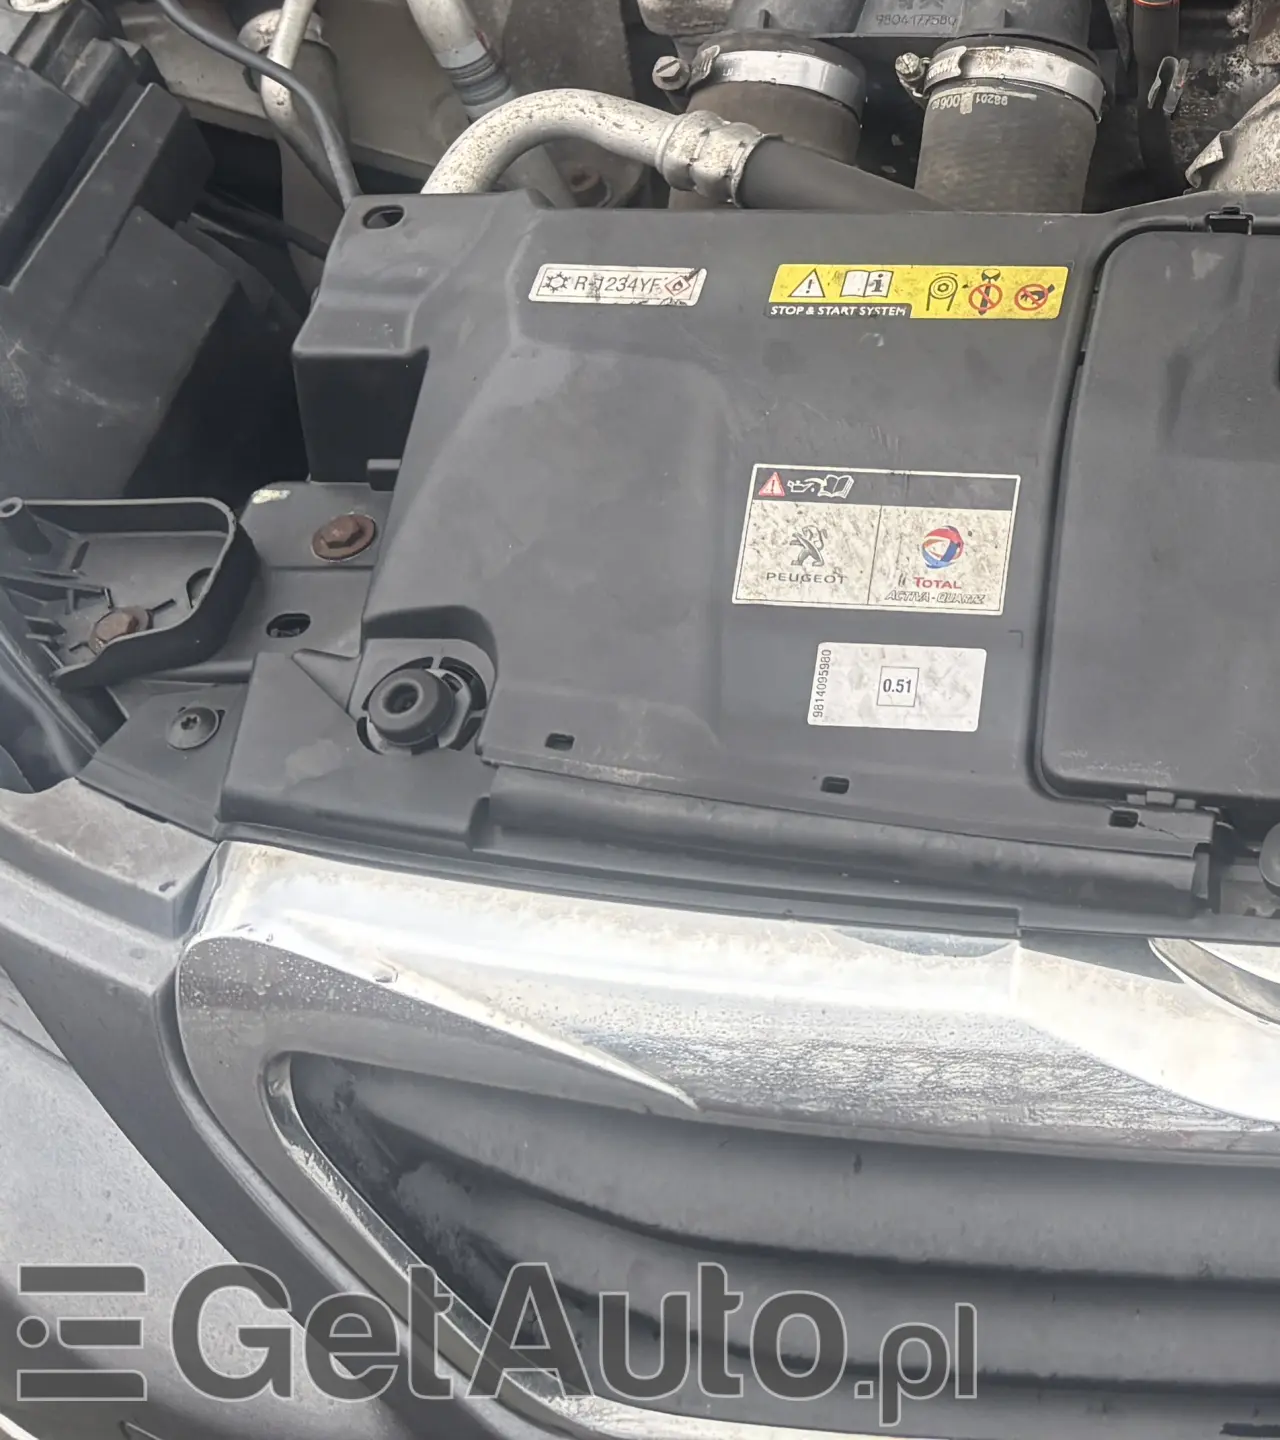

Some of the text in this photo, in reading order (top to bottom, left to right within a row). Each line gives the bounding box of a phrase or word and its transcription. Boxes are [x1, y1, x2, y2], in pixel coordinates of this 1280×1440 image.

[770, 305, 907, 317] STOP & START SYSTEM
[766, 572, 848, 585] PEUGEOT
[812, 649, 832, 718] 9814095980
[882, 679, 913, 694] 0.51
